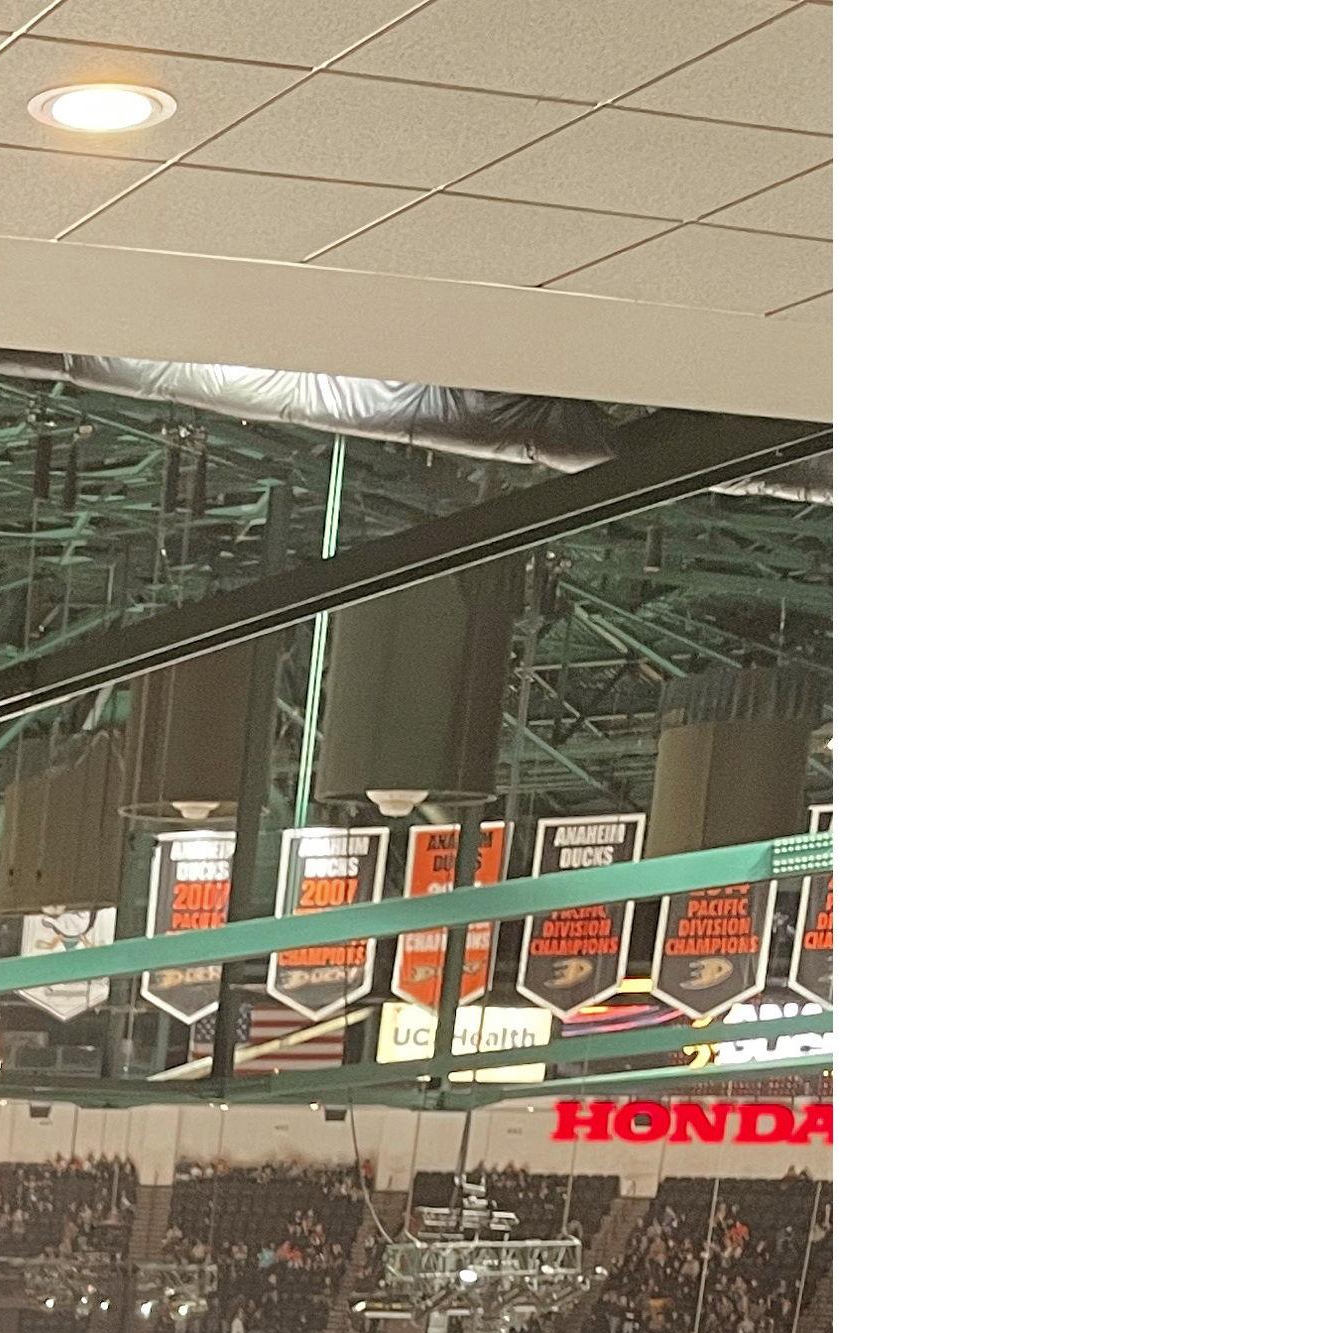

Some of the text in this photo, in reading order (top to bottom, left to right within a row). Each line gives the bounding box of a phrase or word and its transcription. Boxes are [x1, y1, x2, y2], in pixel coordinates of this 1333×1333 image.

[554, 823, 626, 847] ANAHEIM
[559, 845, 615, 868] DUCKS
[301, 878, 359, 906] 2007
[687, 899, 748, 917] PACIFIC
[542, 919, 612, 938] DIVISION
[677, 916, 752, 936] DIVISION
[530, 936, 619, 956] CHAMPIONS
[665, 935, 759, 956] CHAMPIONS
[550, 1101, 833, 1144] HONDA
